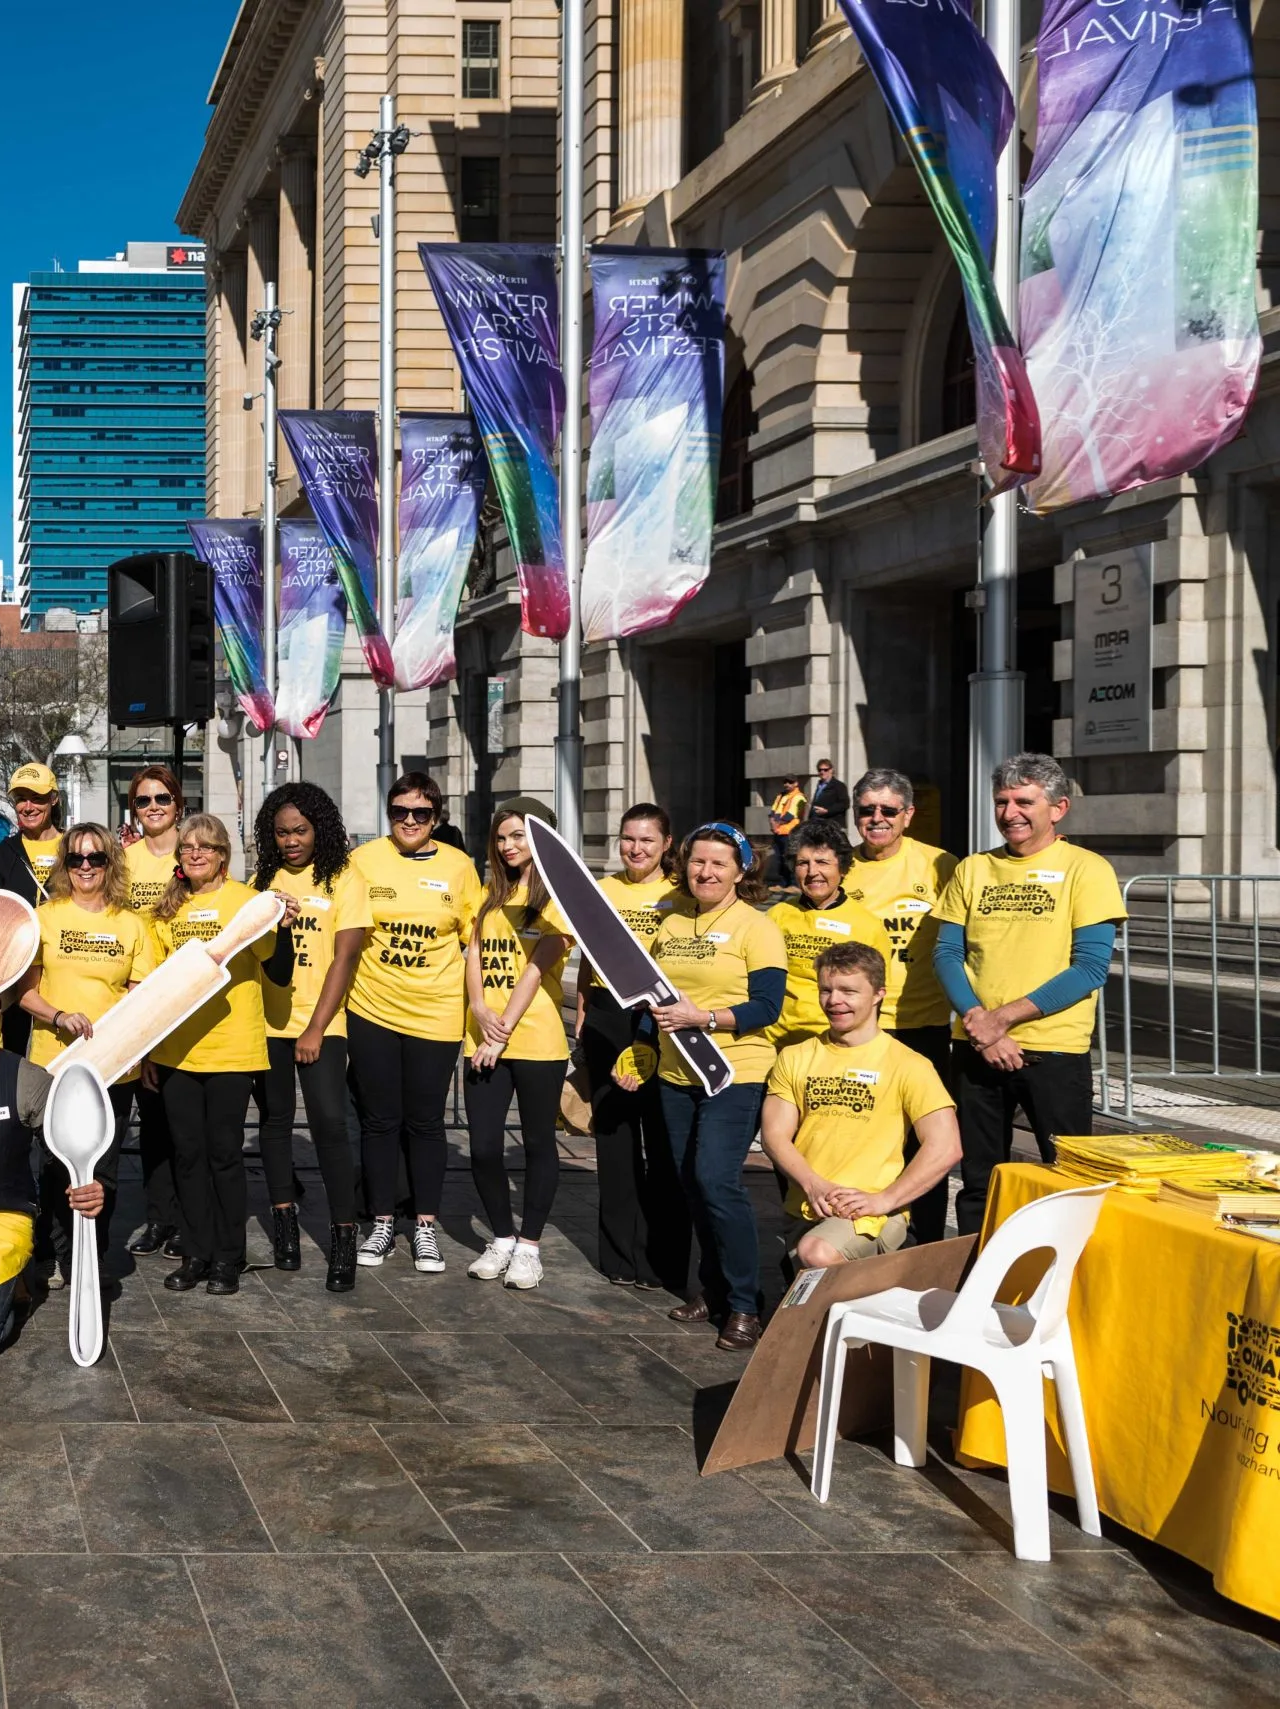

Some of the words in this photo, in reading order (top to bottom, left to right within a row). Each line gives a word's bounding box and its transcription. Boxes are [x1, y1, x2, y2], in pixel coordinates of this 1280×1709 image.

[445, 289, 548, 318] WINTER
[473, 312, 537, 339] ARTS
[460, 337, 562, 373] FESTIVAL
[302, 445, 370, 464] WINTER
[315, 462, 362, 480] ARTS
[212, 559, 250, 573] ARTS
[217, 573, 262, 588] STIVAL
[1101, 564, 1123, 605] 3
[1088, 683, 1136, 703] AECOM
[988, 893, 1045, 903] OZHARVEST
[177, 930, 219, 938] OZHARVEST
[389, 936, 427, 953] EAT.
[481, 938, 522, 956] HINK.
[379, 949, 431, 968] SAVE.
[482, 956, 513, 971] EAT.
[483, 974, 515, 990] AVE
[812, 1087, 864, 1096] OZHAVEST
[1242, 1347, 1280, 1380] OZHA
